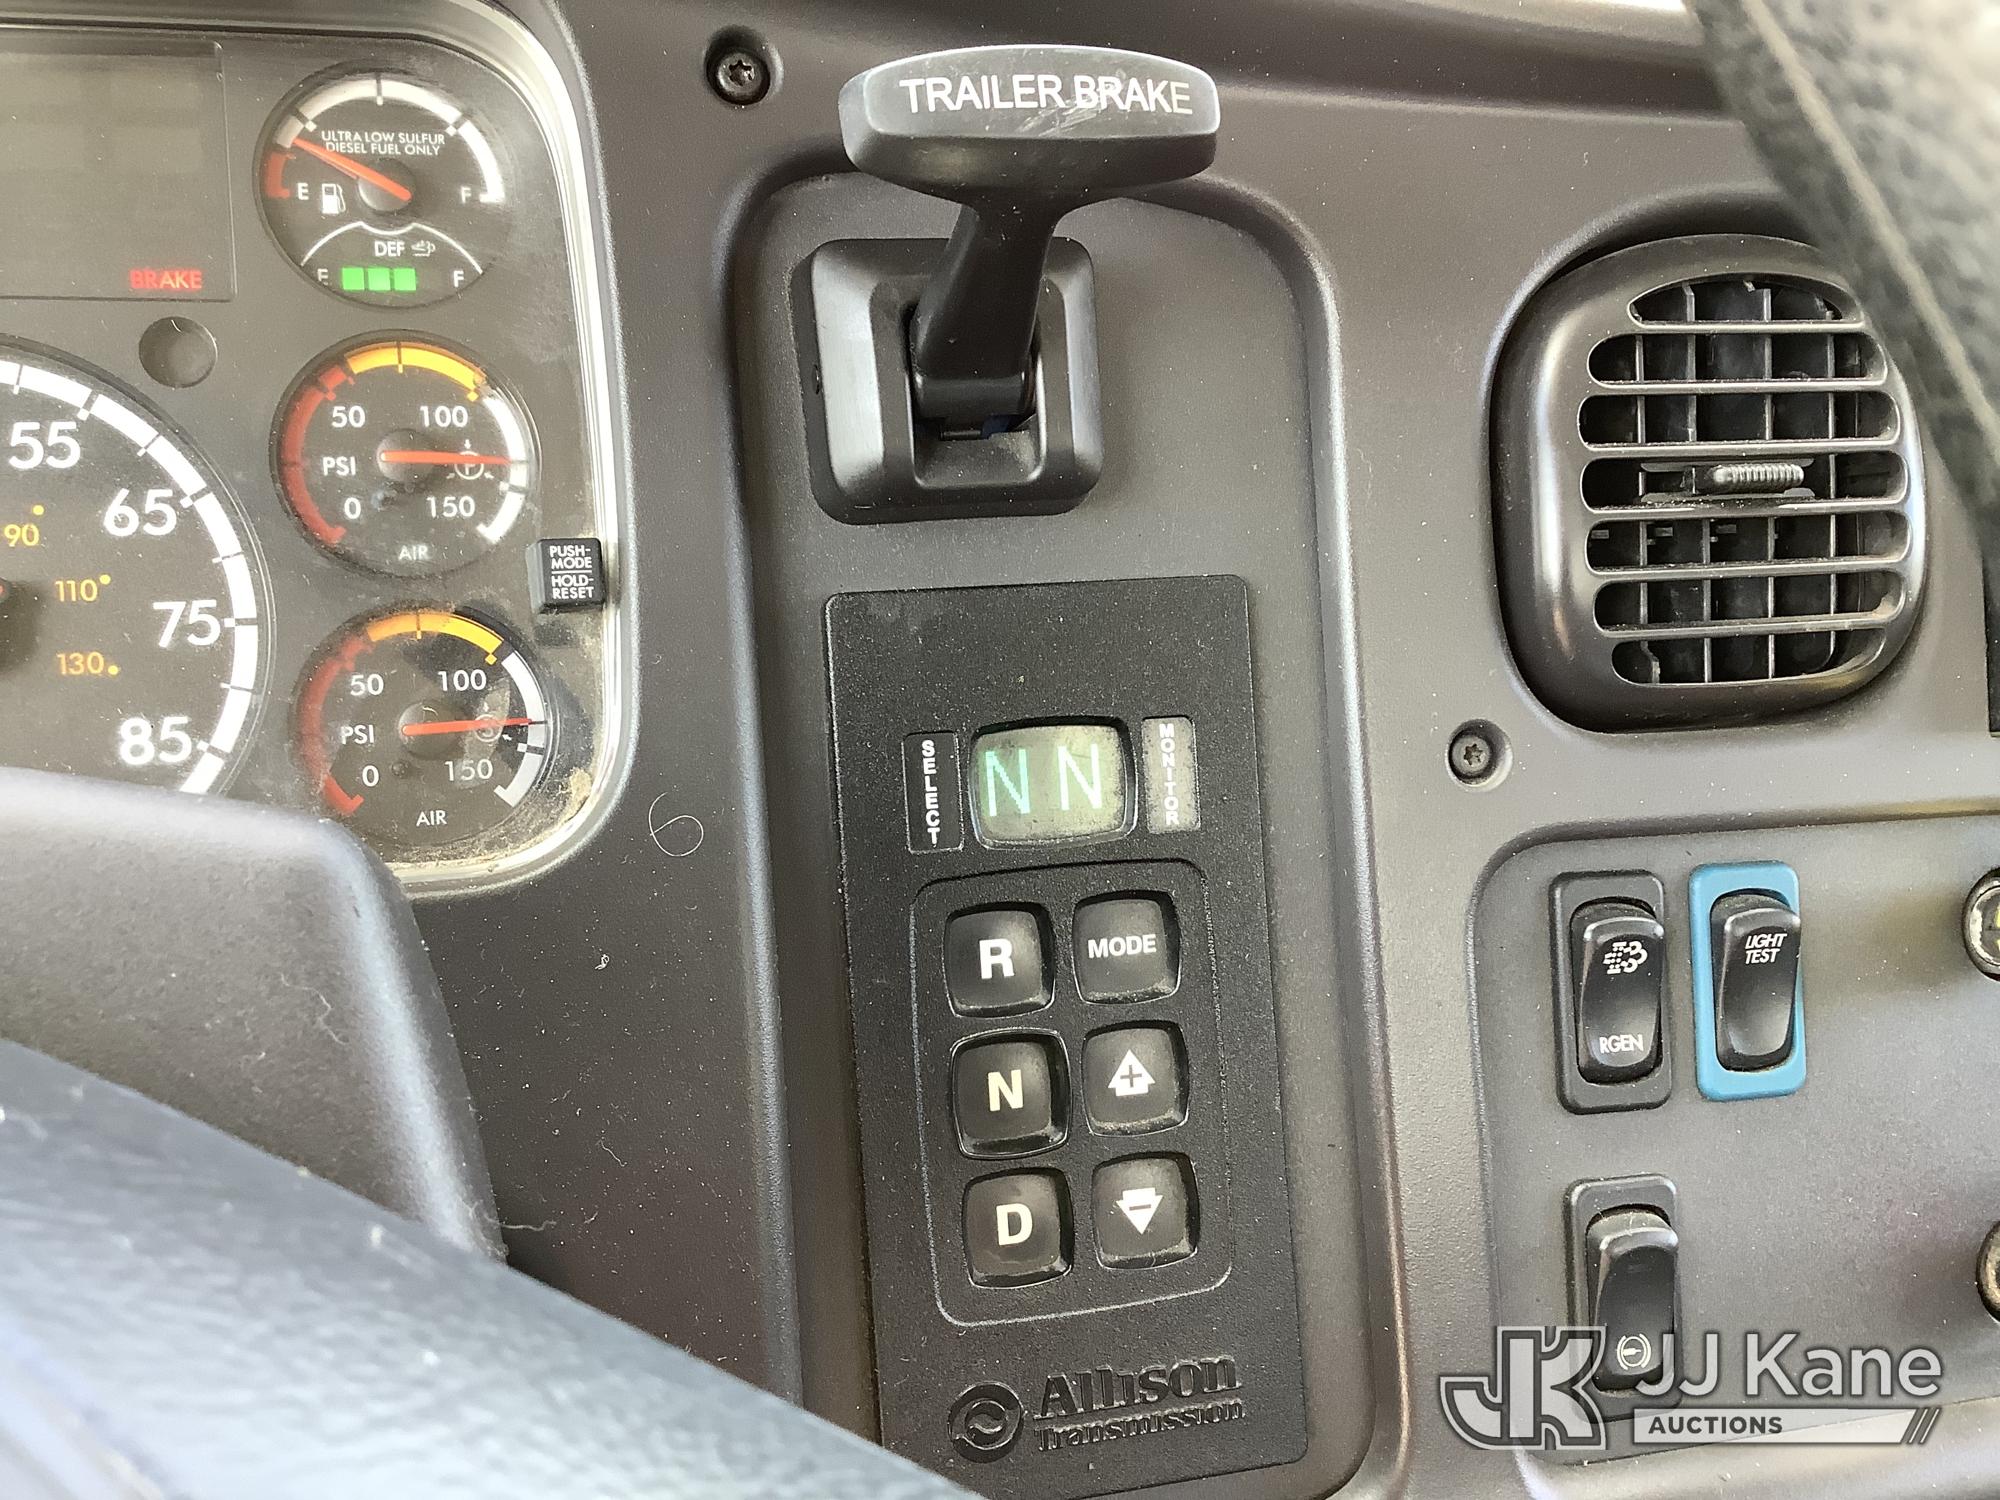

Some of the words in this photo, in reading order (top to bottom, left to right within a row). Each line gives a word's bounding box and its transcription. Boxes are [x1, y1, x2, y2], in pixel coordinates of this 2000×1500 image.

[899, 74, 1065, 113] TRAILER
[1073, 75, 1193, 115] BRAKE
[321, 130, 363, 143] ULTRA
[364, 131, 395, 143] LOW
[398, 132, 446, 145] SULFUR
[325, 141, 368, 154] DIESEL
[370, 143, 402, 155] FUEL
[404, 144, 440, 156] ONLY
[298, 183, 309, 201] E
[460, 186, 472, 203] F
[374, 241, 406, 257] DEF
[129, 268, 202, 289] BRAKE
[317, 268, 329, 286] E
[452, 270, 465, 288] F
[331, 405, 366, 428] 50
[419, 405, 470, 428] 100
[8, 421, 81, 469] 55
[322, 456, 357, 476] PSI
[103, 488, 177, 536] 65
[343, 497, 362, 520] 0
[426, 496, 476, 518] 150
[4, 523, 40, 547] 90
[399, 546, 430, 561] AIR
[551, 556, 592, 570] MODE
[55, 579, 99, 603] 110
[552, 586, 594, 599] RESET
[152, 600, 221, 648] 75
[57, 652, 105, 677] 130
[349, 674, 384, 696] 50
[438, 669, 487, 692] 100
[118, 716, 193, 766] 85
[339, 725, 375, 744] PSI
[362, 766, 380, 787] 0
[444, 759, 494, 782] 150
[985, 748, 1031, 817] N
[1056, 743, 1103, 811] N
[1159, 723, 1179, 825] MONITOR
[921, 739, 941, 845] SELECT
[416, 810, 447, 827] AIR
[1088, 934, 1157, 959] MODE
[1745, 933, 1788, 949] LIGHT
[978, 937, 1015, 980] R
[1745, 948, 1781, 965] TEST
[1599, 1033, 1644, 1055] RGEN
[987, 1069, 1024, 1112] N
[996, 1203, 1034, 1246] D
[1033, 1354, 1243, 1421] Allison
[1033, 1397, 1247, 1452] Transmission
